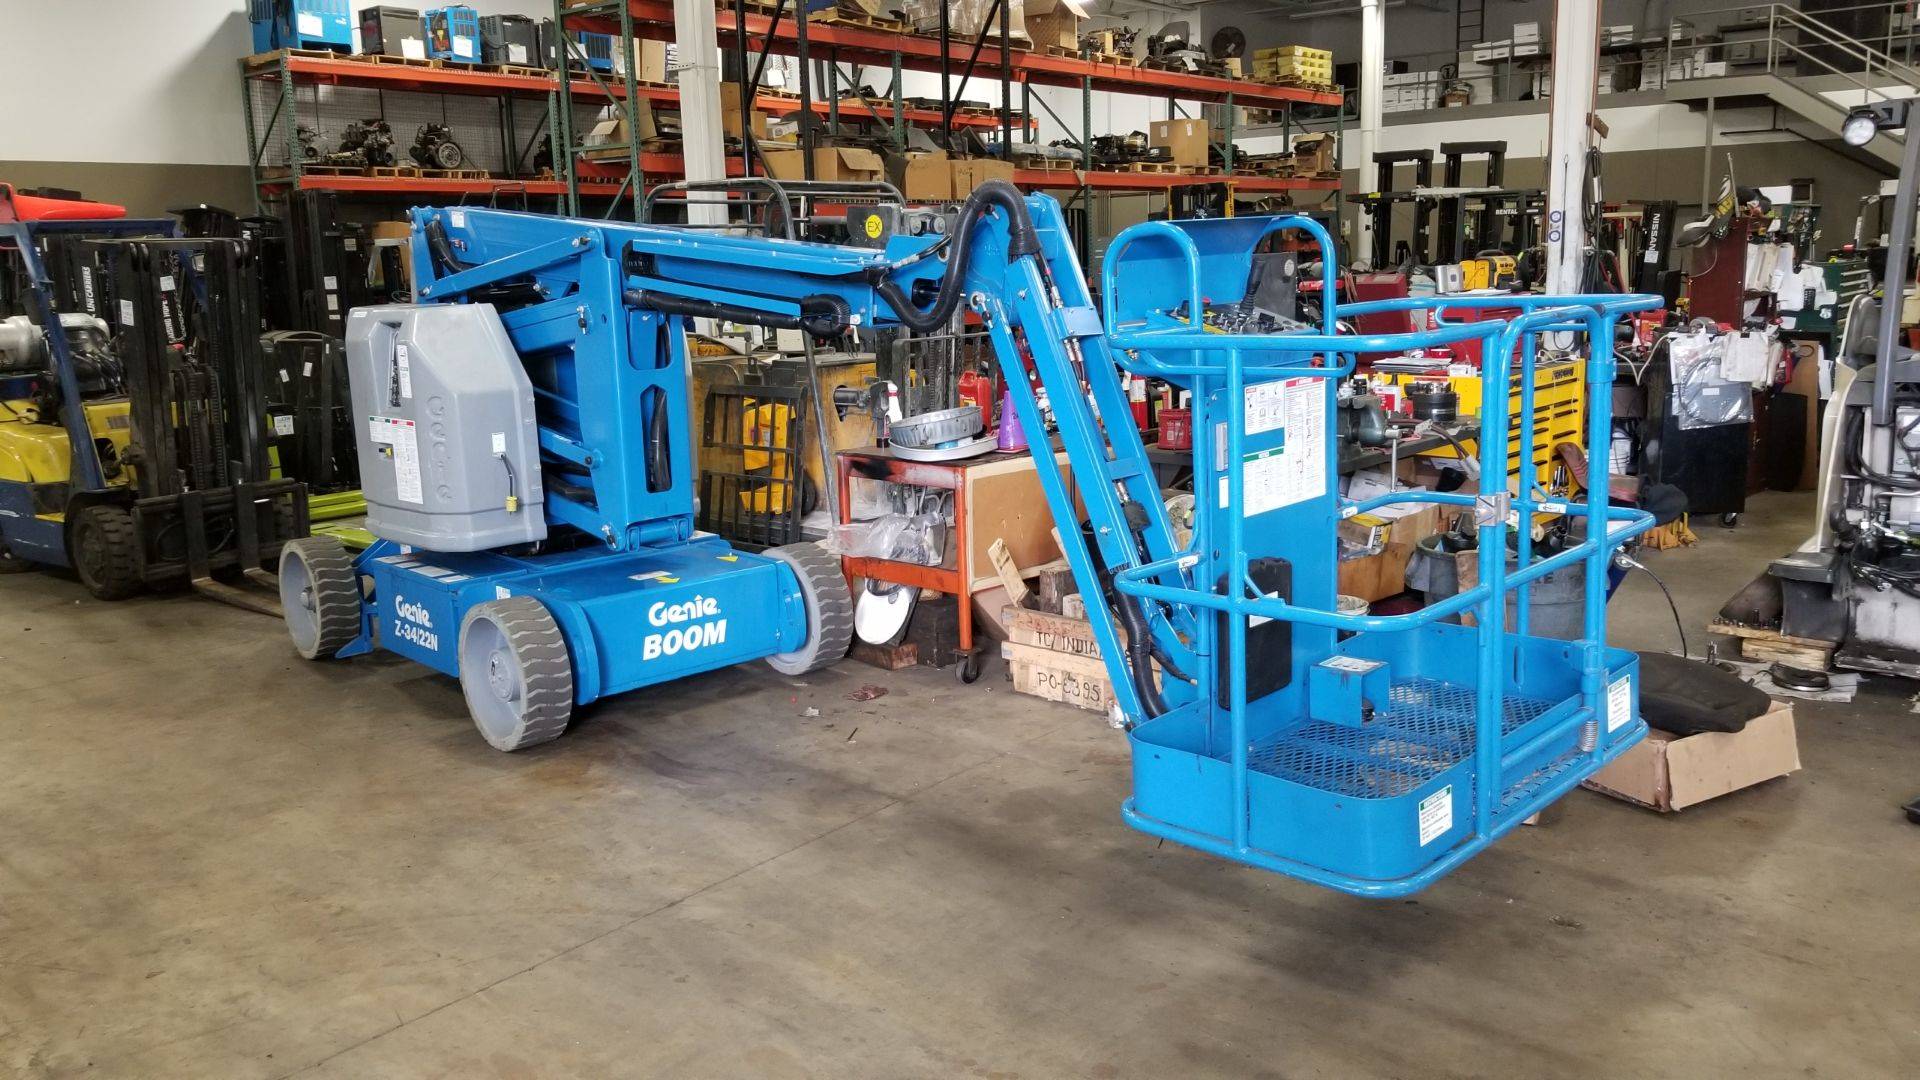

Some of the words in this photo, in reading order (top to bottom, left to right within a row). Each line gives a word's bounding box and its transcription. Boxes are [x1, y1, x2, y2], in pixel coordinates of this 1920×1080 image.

[867, 221, 881, 233] EX
[1648, 213, 1661, 251] NISSAN
[395, 594, 431, 627] Genie
[648, 594, 718, 627] Genie
[394, 620, 439, 652] Z-34/22N
[643, 619, 728, 661] BOOM
